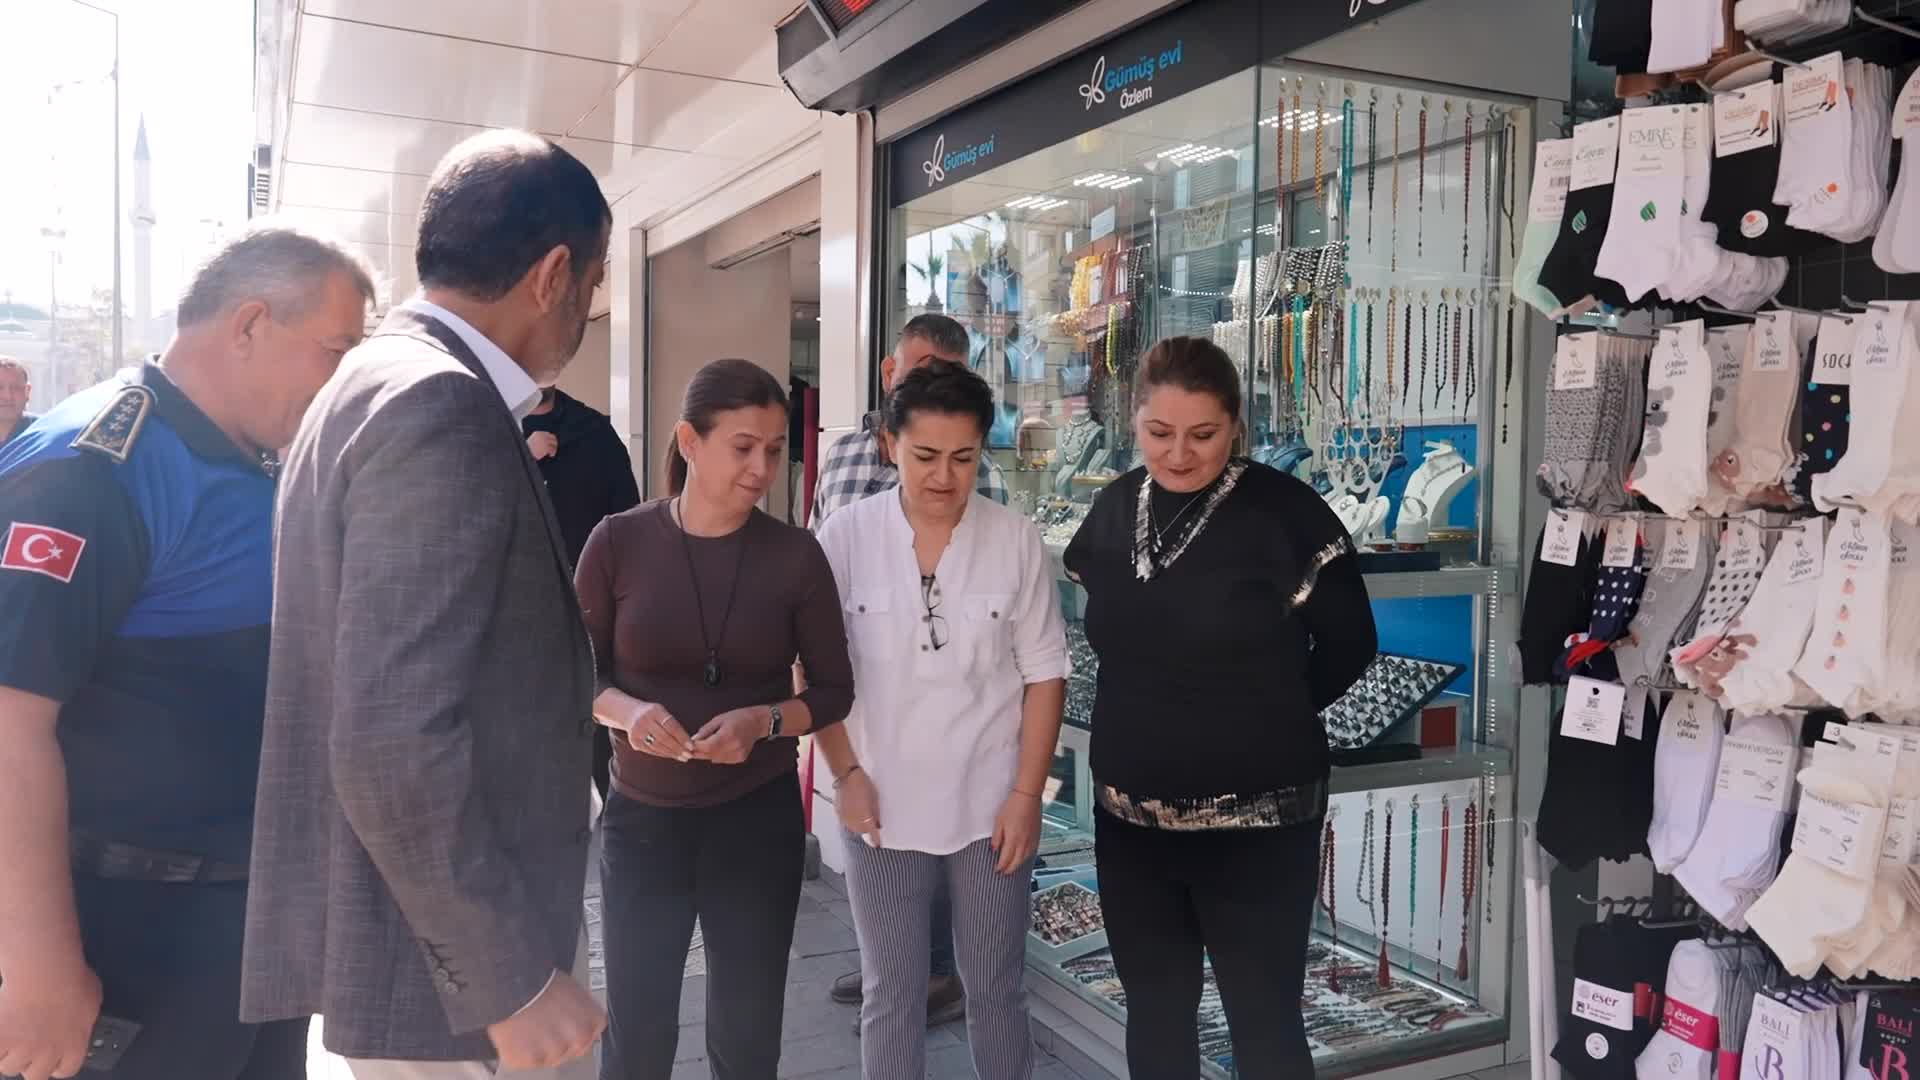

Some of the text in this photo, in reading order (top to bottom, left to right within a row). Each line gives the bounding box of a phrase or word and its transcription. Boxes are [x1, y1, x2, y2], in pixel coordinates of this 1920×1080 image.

[1104, 39, 1183, 93] Gümüş evi
[1120, 86, 1153, 110] Özlem
[1629, 127, 1674, 150] EMRE
[943, 133, 995, 172] Gümüş evi
[1591, 991, 1619, 1008] eser
[1673, 1009, 1700, 1028] eser
